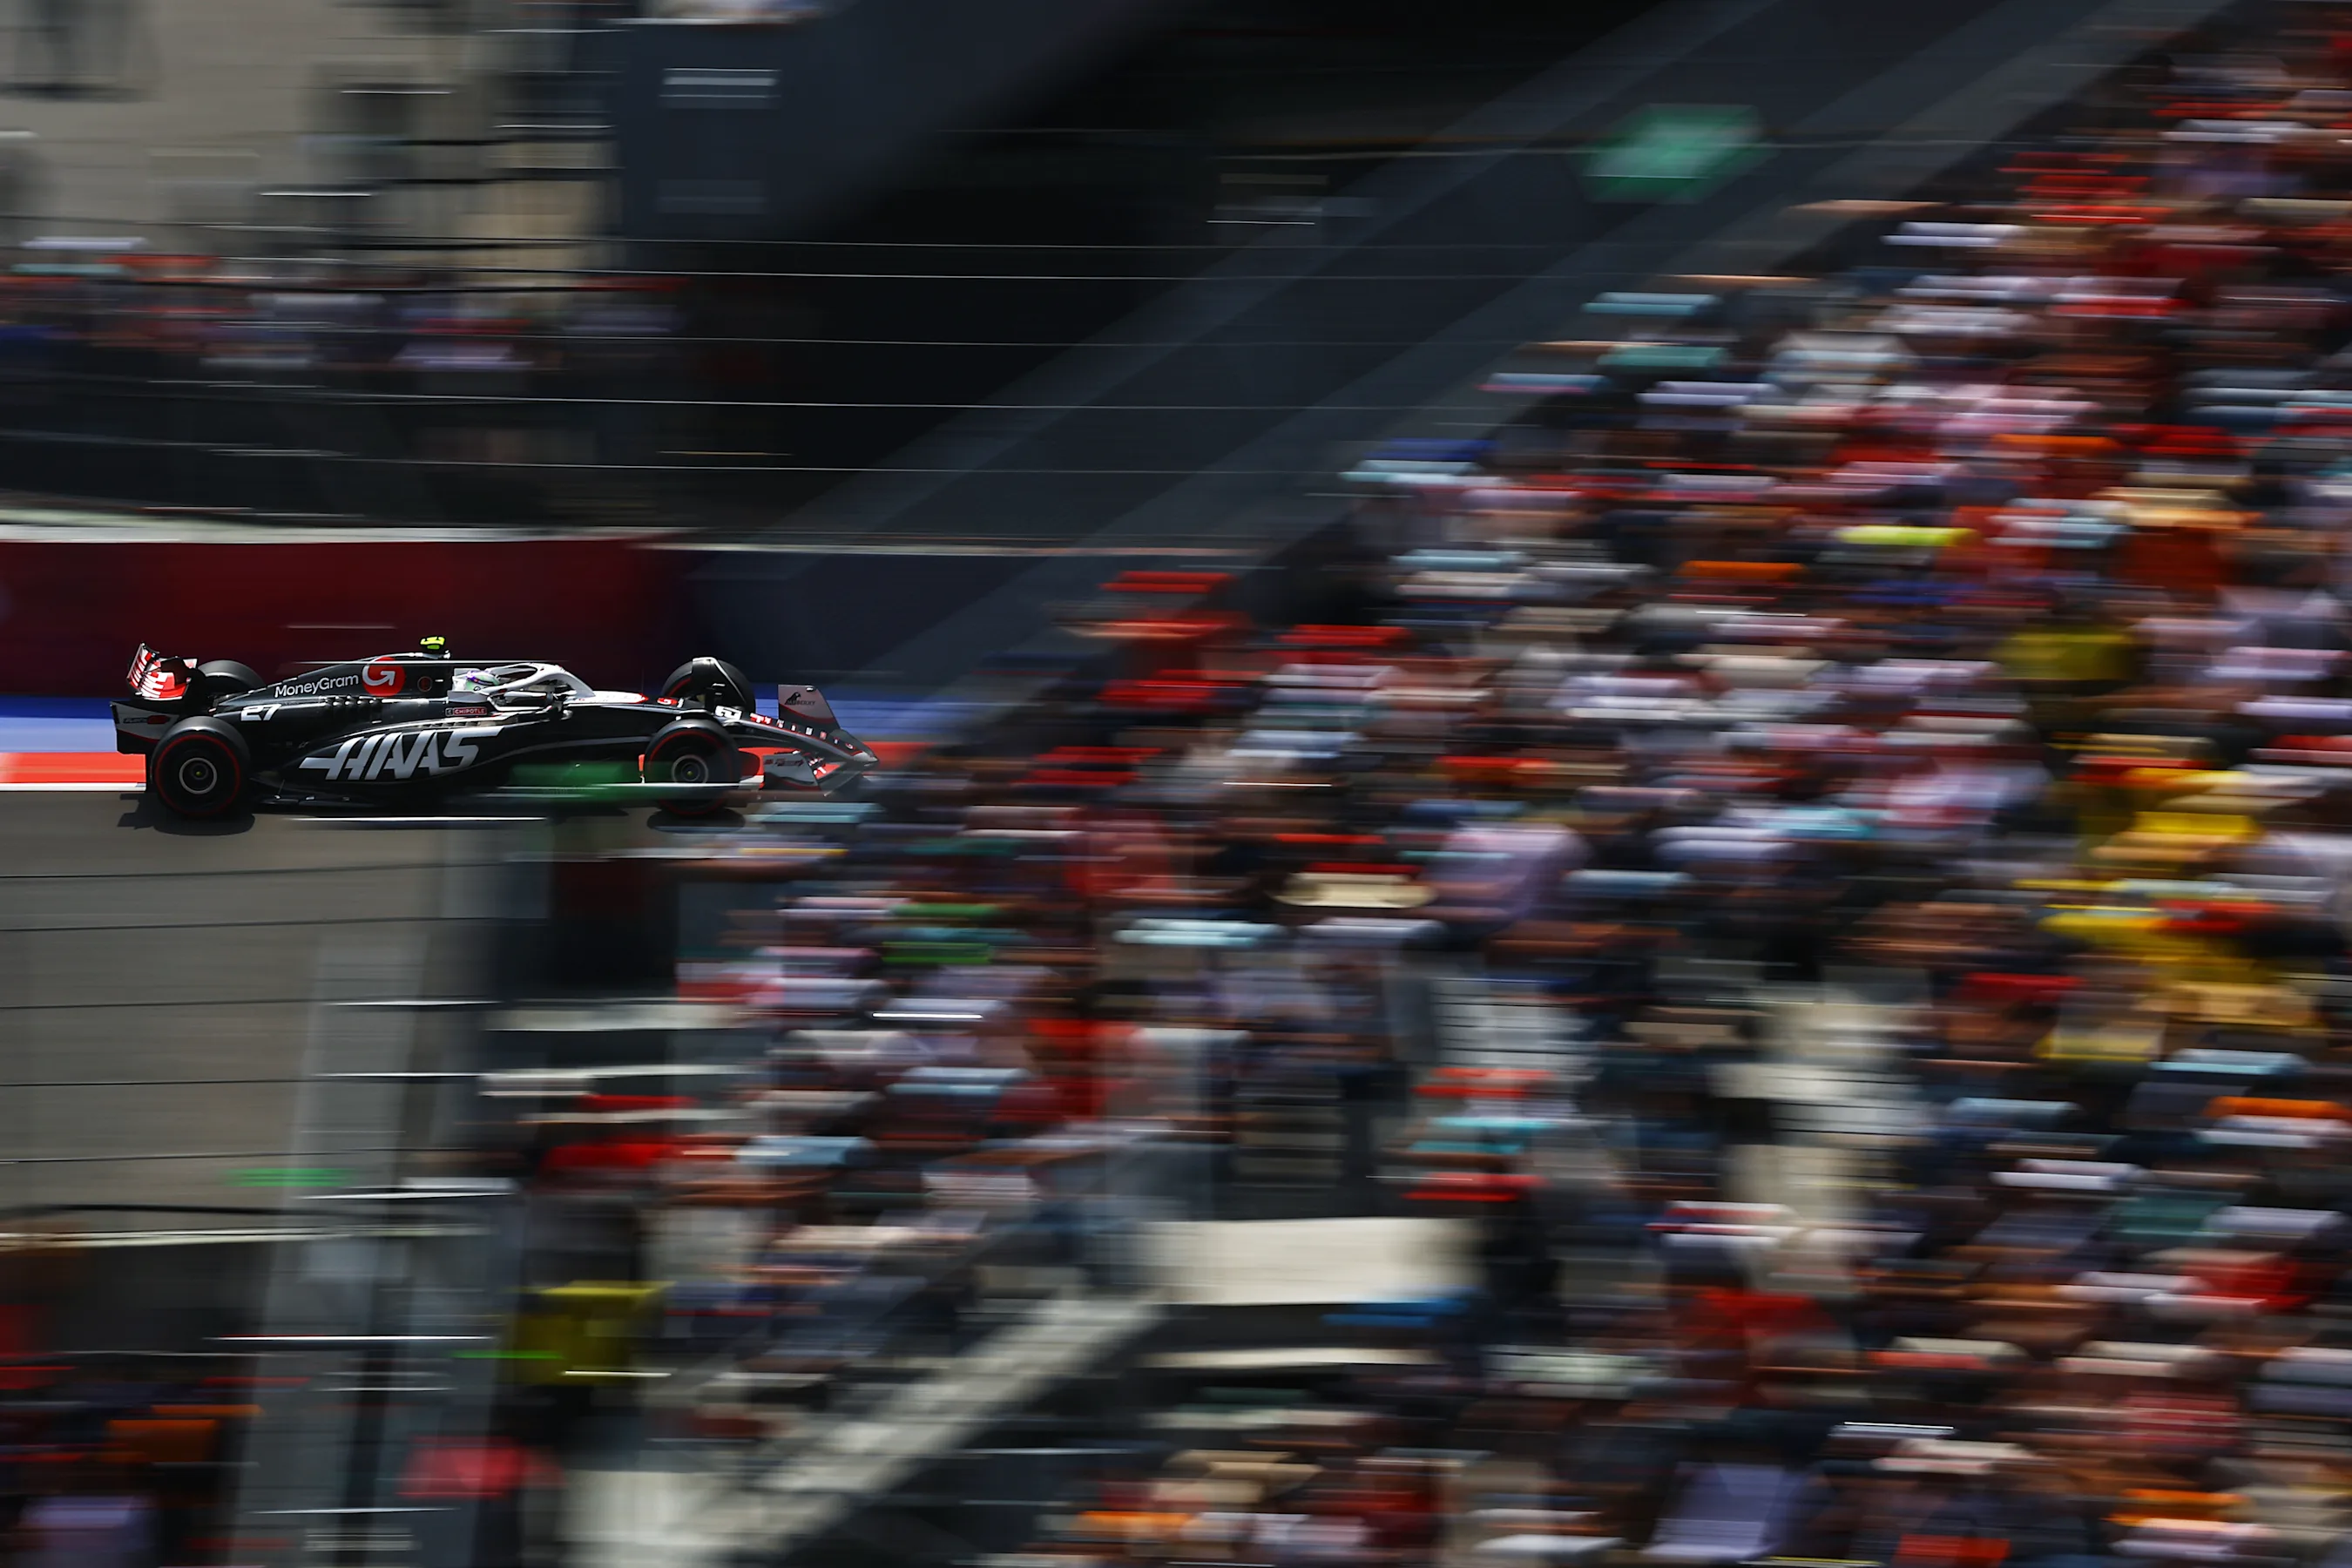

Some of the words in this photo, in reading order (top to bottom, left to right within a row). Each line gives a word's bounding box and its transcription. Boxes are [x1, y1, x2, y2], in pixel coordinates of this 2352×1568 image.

[274, 675, 359, 698] MoneyGram
[240, 704, 281, 721] 27
[299, 727, 504, 780] HAAS
